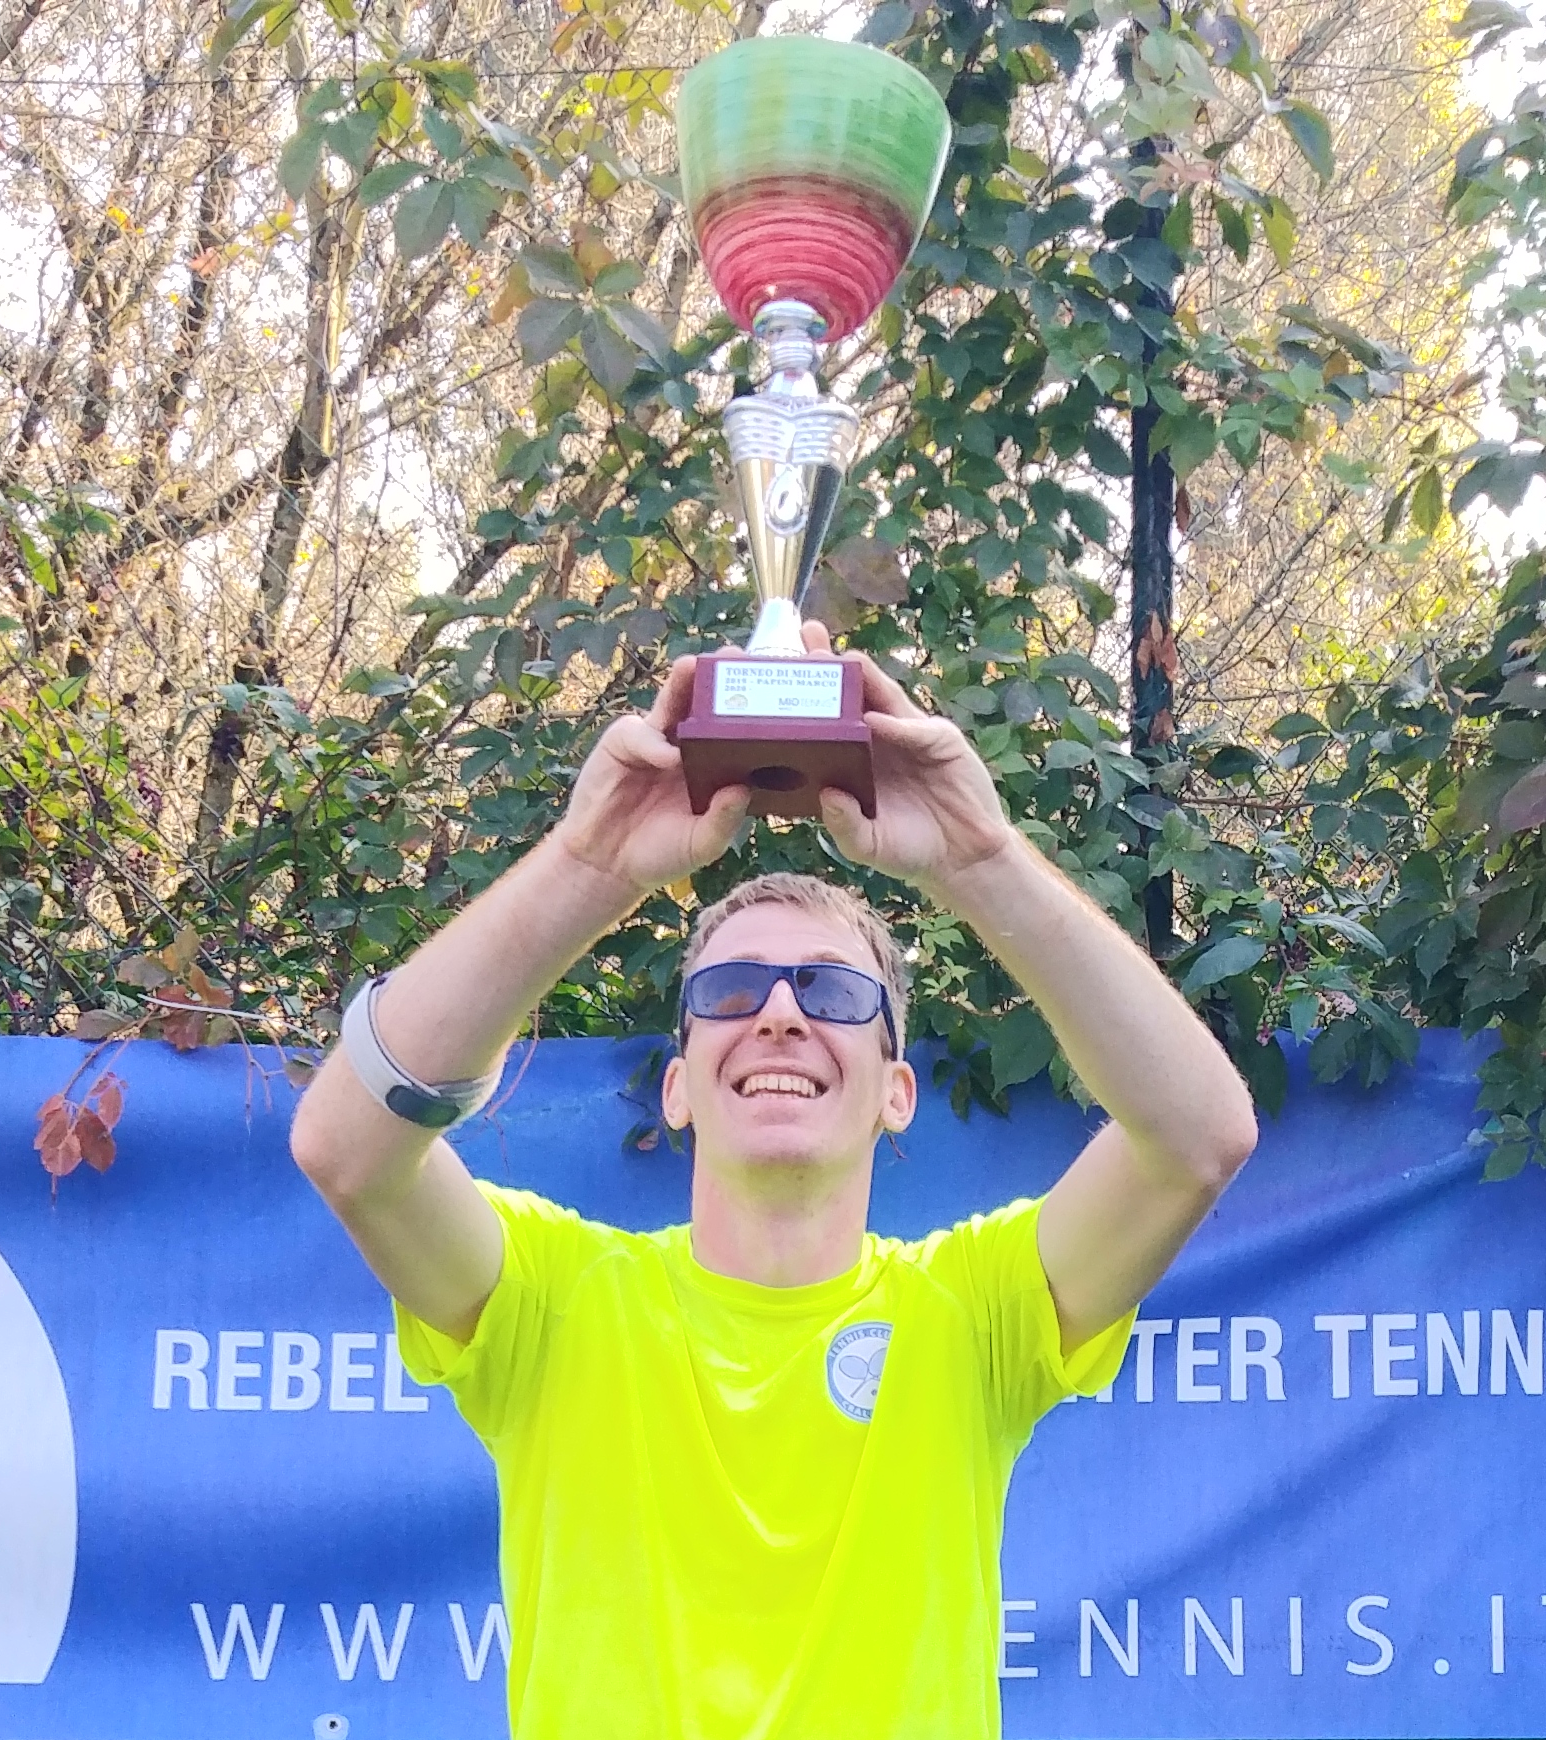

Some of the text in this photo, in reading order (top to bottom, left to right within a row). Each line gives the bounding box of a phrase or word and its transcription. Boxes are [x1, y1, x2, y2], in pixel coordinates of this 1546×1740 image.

[725, 667, 839, 679] TORNEO DI MILANO
[757, 678, 793, 686] PAPINI
[796, 679, 837, 687] MARCO
[829, 1330, 865, 1358] TENNIS
[153, 1329, 429, 1413] REBEL
